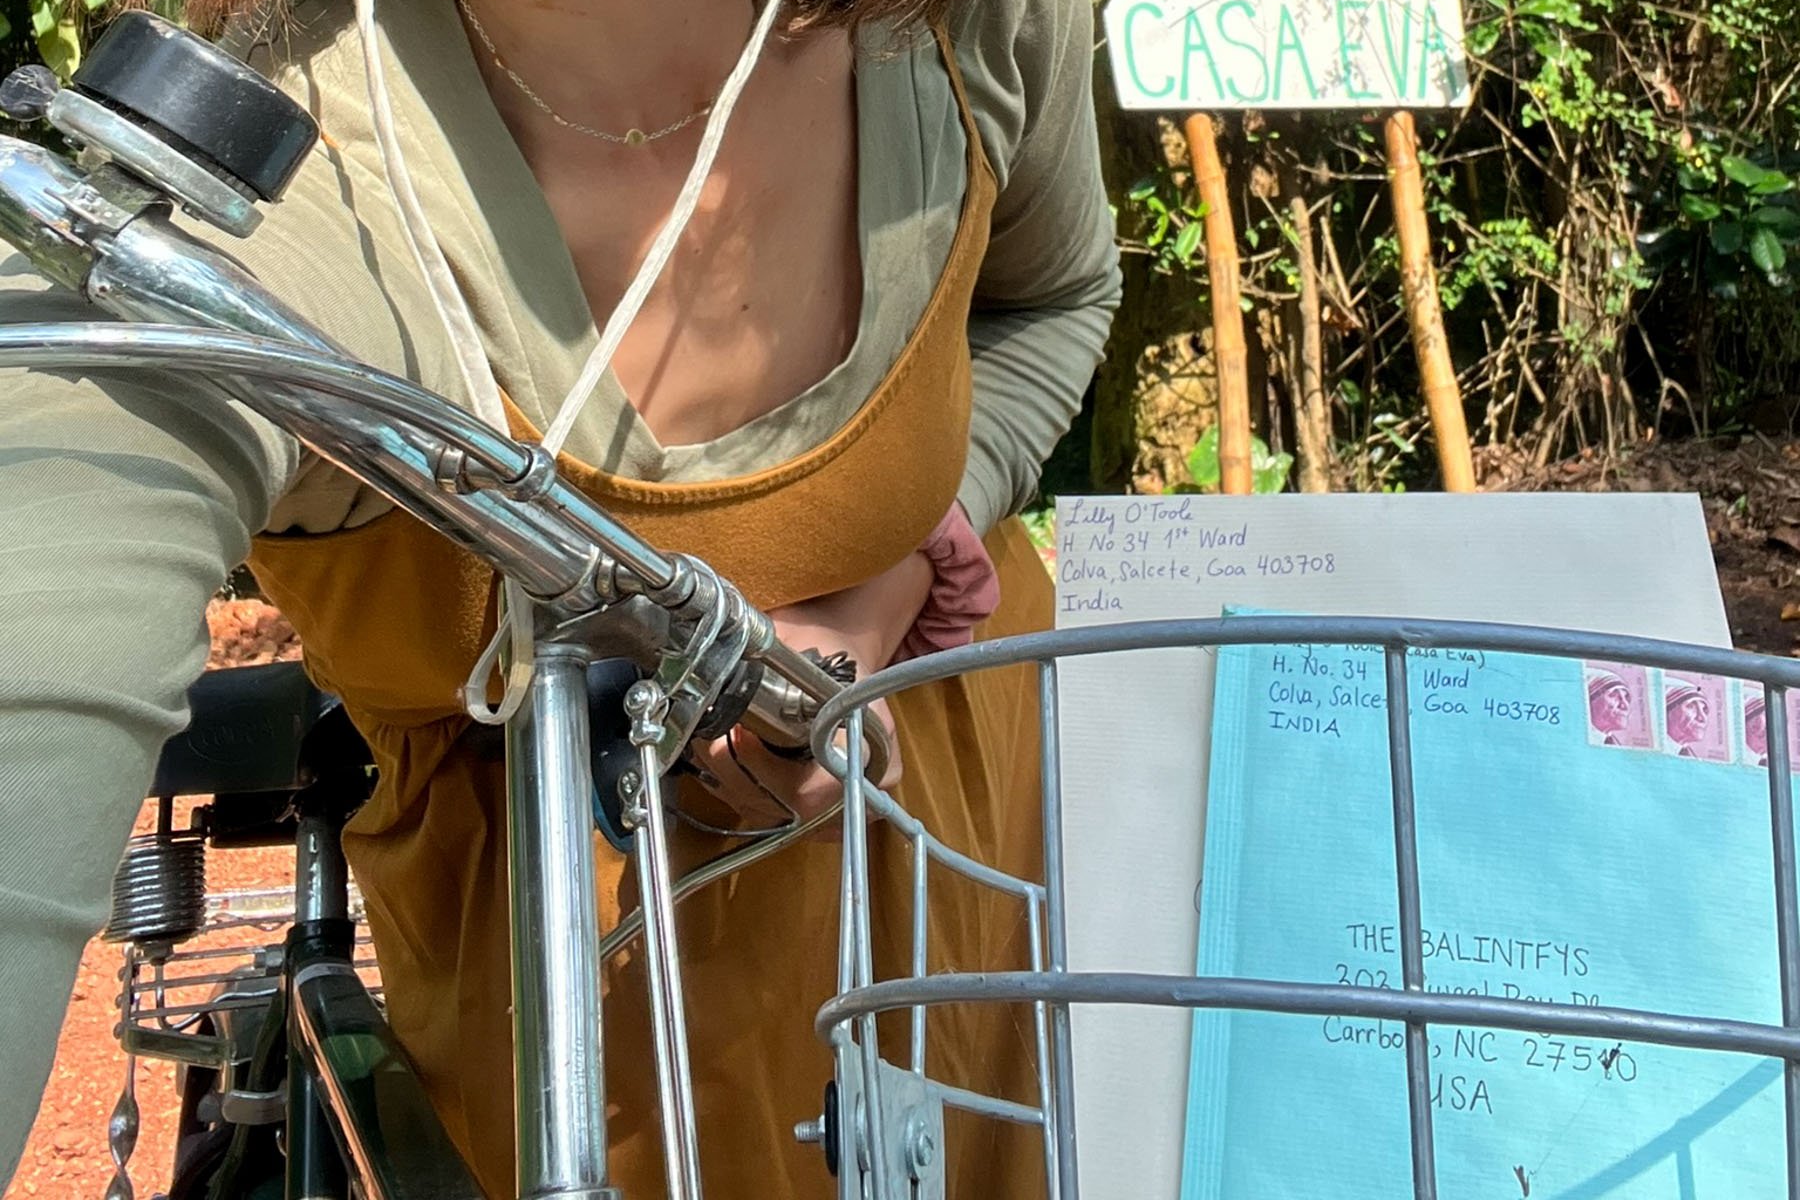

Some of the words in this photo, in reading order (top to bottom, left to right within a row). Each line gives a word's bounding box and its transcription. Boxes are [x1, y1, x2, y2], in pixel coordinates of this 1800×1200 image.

[1064, 498, 1115, 535] Lilly
[1063, 533, 1074, 552] H
[1089, 534, 1114, 552] No
[1123, 531, 1149, 553] 34
[1199, 523, 1247, 548] Ward
[1062, 558, 1115, 585] Colva,
[1206, 557, 1246, 577] Goa
[1257, 553, 1336, 576] 403708
[1061, 588, 1123, 612] India
[1272, 654, 1293, 674] H.
[1342, 659, 1367, 680] 34
[1423, 667, 1469, 689] Ward
[1269, 711, 1341, 738] INDIA
[1424, 693, 1469, 714] Goa
[1484, 697, 1561, 726] 403708
[1346, 923, 1395, 953] THE
[1454, 1029, 1499, 1063] NC
